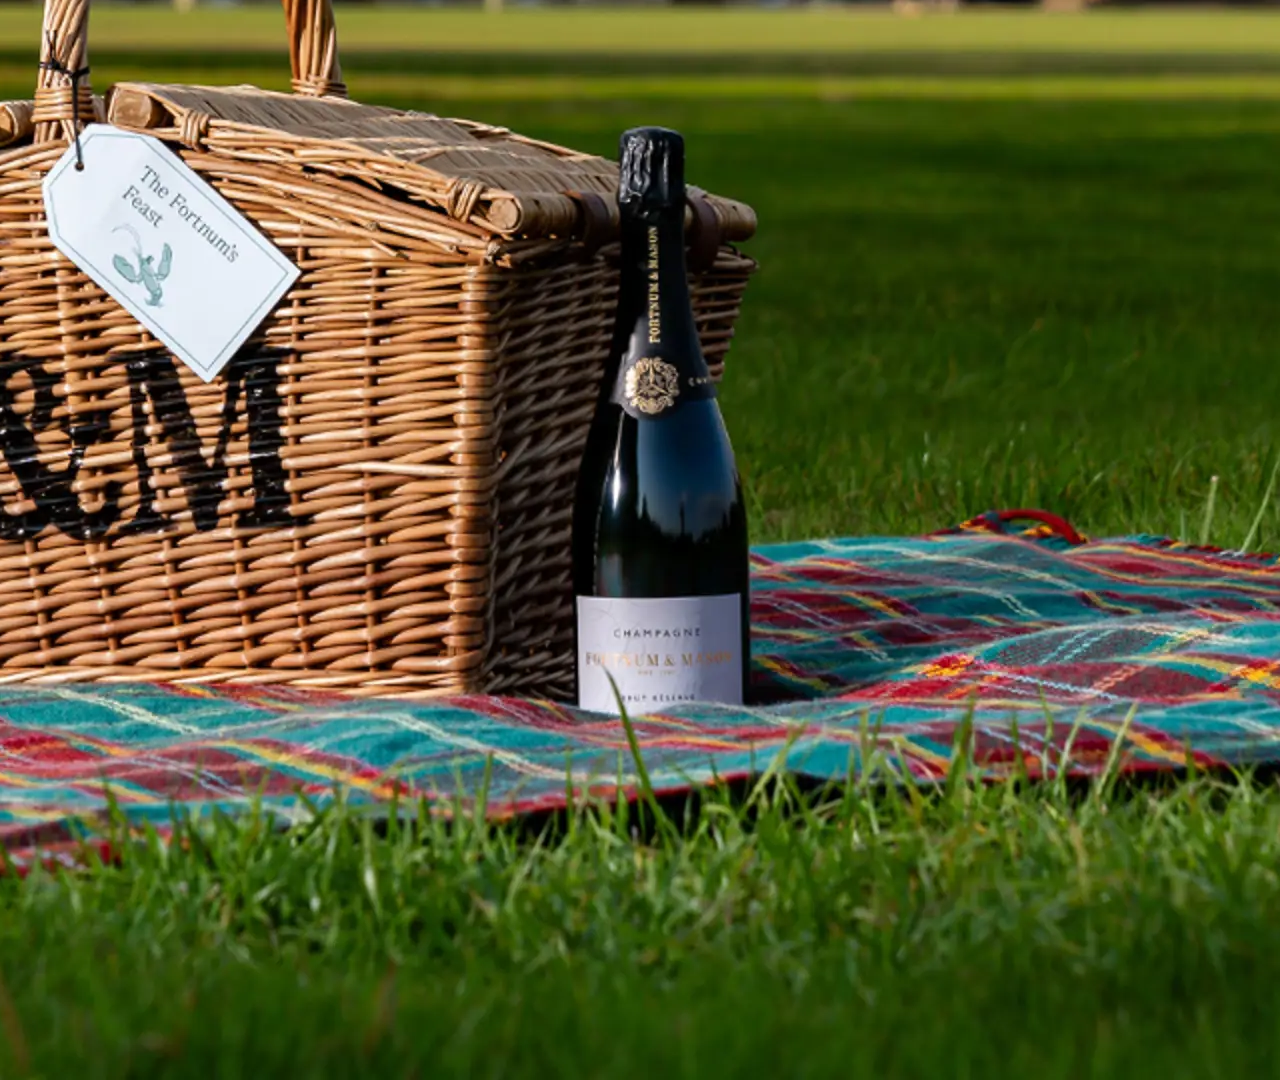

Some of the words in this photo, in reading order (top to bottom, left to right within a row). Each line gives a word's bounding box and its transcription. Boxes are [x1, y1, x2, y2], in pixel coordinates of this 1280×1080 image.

[121, 184, 164, 229] Feast
[140, 165, 170, 199] The
[168, 192, 241, 264] Fortnum's
[648, 227, 659, 269] MASON
[648, 271, 659, 280] &
[649, 282, 661, 343] FORTNUM
[614, 628, 701, 638] CHAMPAGNE
[663, 653, 676, 667] &
